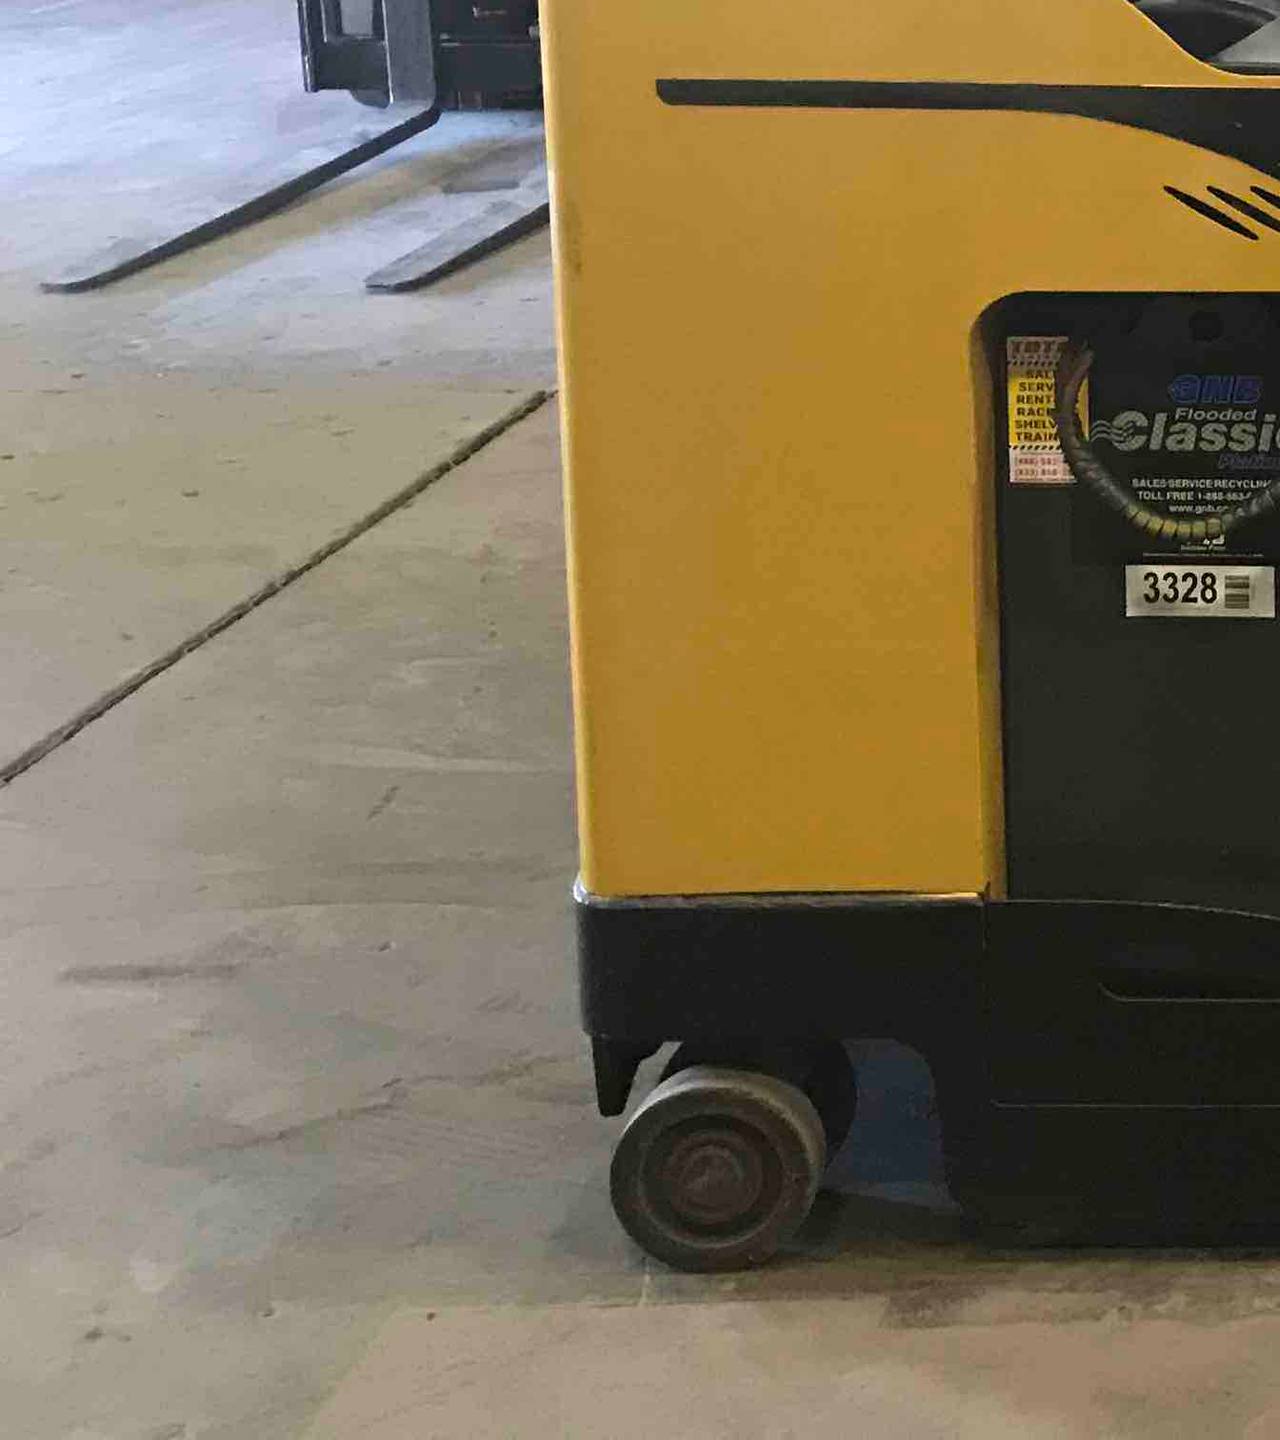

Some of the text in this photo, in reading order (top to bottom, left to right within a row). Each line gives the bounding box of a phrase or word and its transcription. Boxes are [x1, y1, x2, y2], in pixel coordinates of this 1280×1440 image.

[1018, 382, 1054, 392] SERV
[1016, 395, 1053, 405] RENT
[1175, 408, 1257, 422] Flooded
[1015, 420, 1056, 430] SHELV
[1015, 432, 1058, 442] TRAIN
[1132, 479, 1166, 488] SALES
[1168, 479, 1214, 488] SERVICE
[1138, 491, 1163, 500] TOLL
[1166, 491, 1194, 500] FREE
[1168, 504, 1230, 514] www.gnb.co
[1143, 572, 1218, 604] 3328
